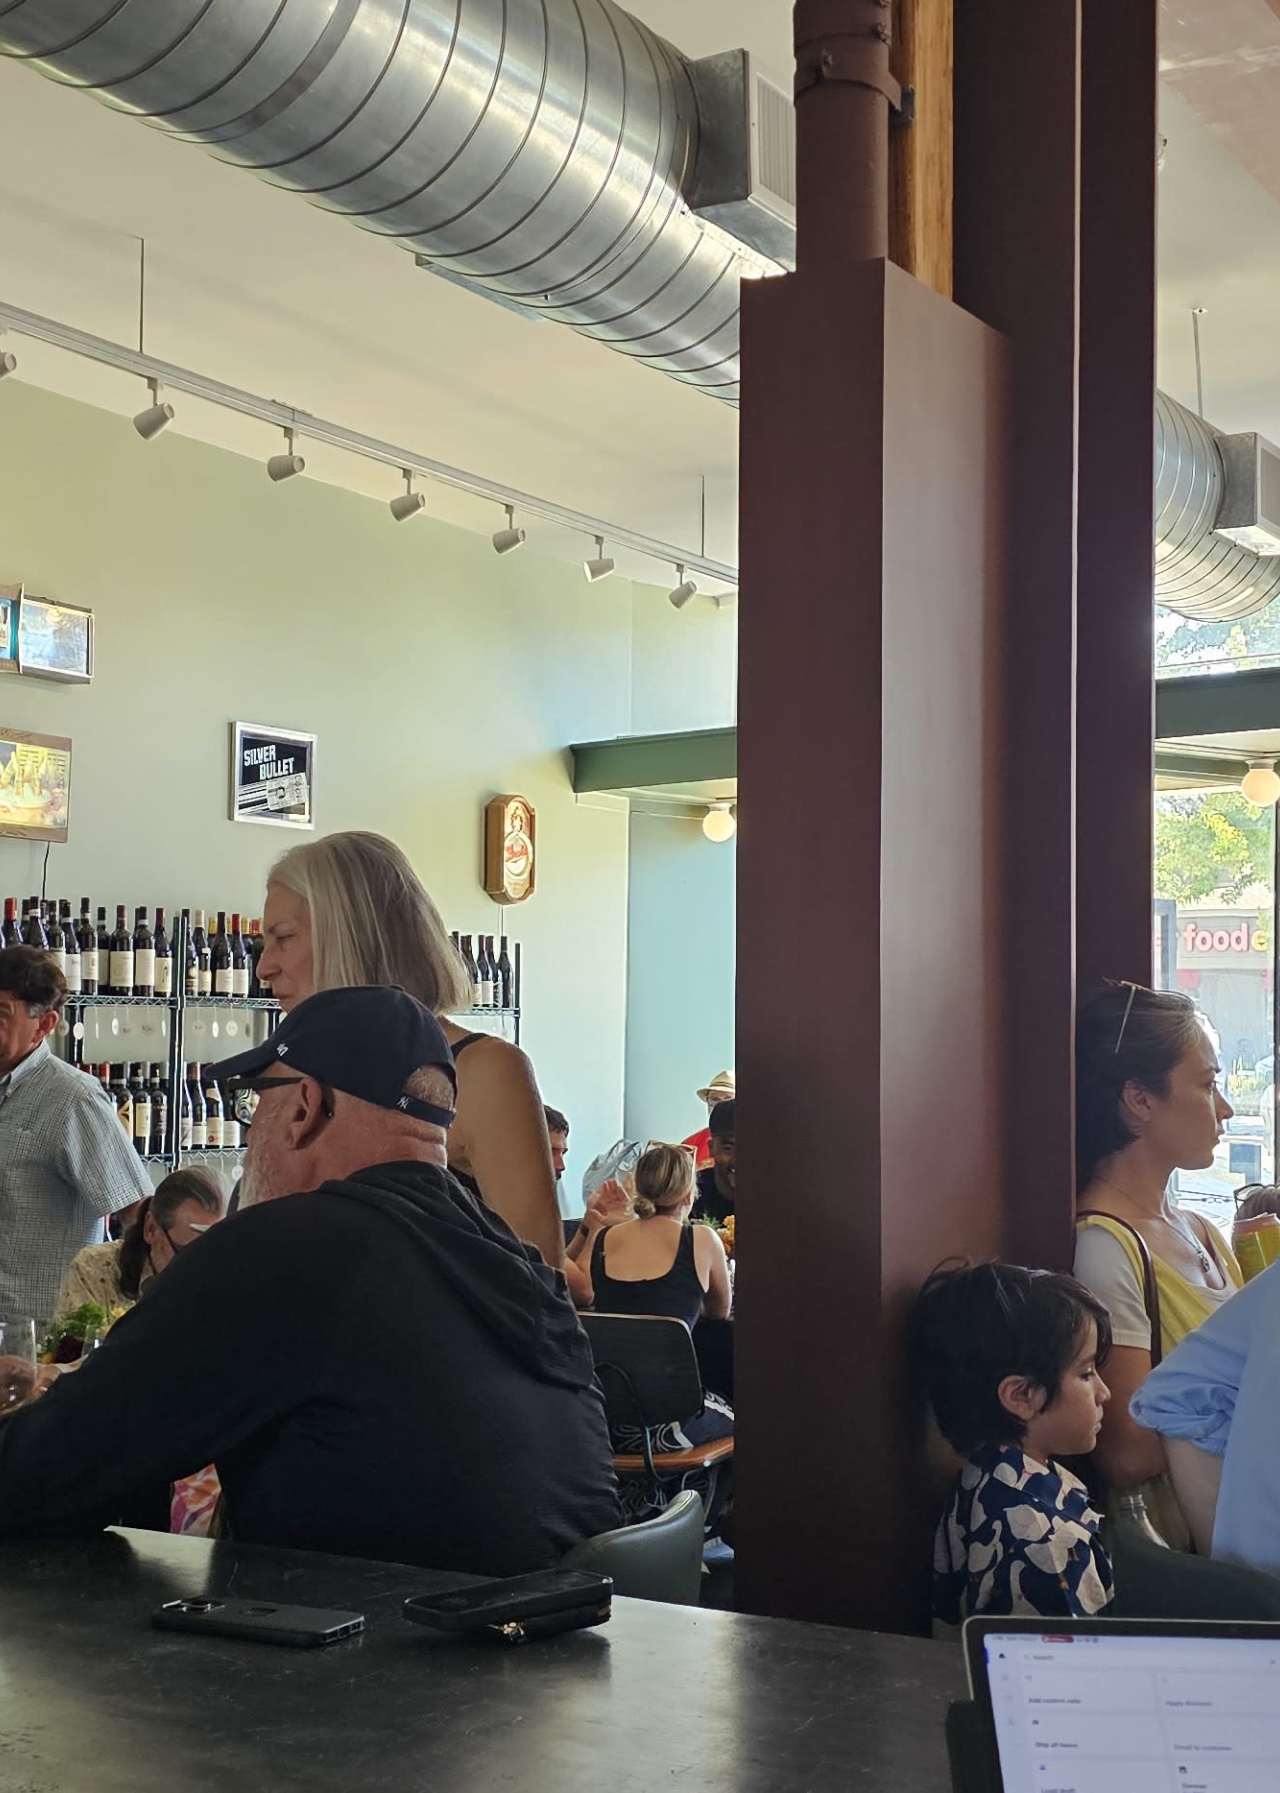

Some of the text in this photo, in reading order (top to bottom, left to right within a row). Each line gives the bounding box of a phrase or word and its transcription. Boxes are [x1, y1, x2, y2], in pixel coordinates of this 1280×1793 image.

[243, 744, 276, 767] SILVER
[260, 757, 295, 780] BULLET
[1183, 922, 1250, 952] food
